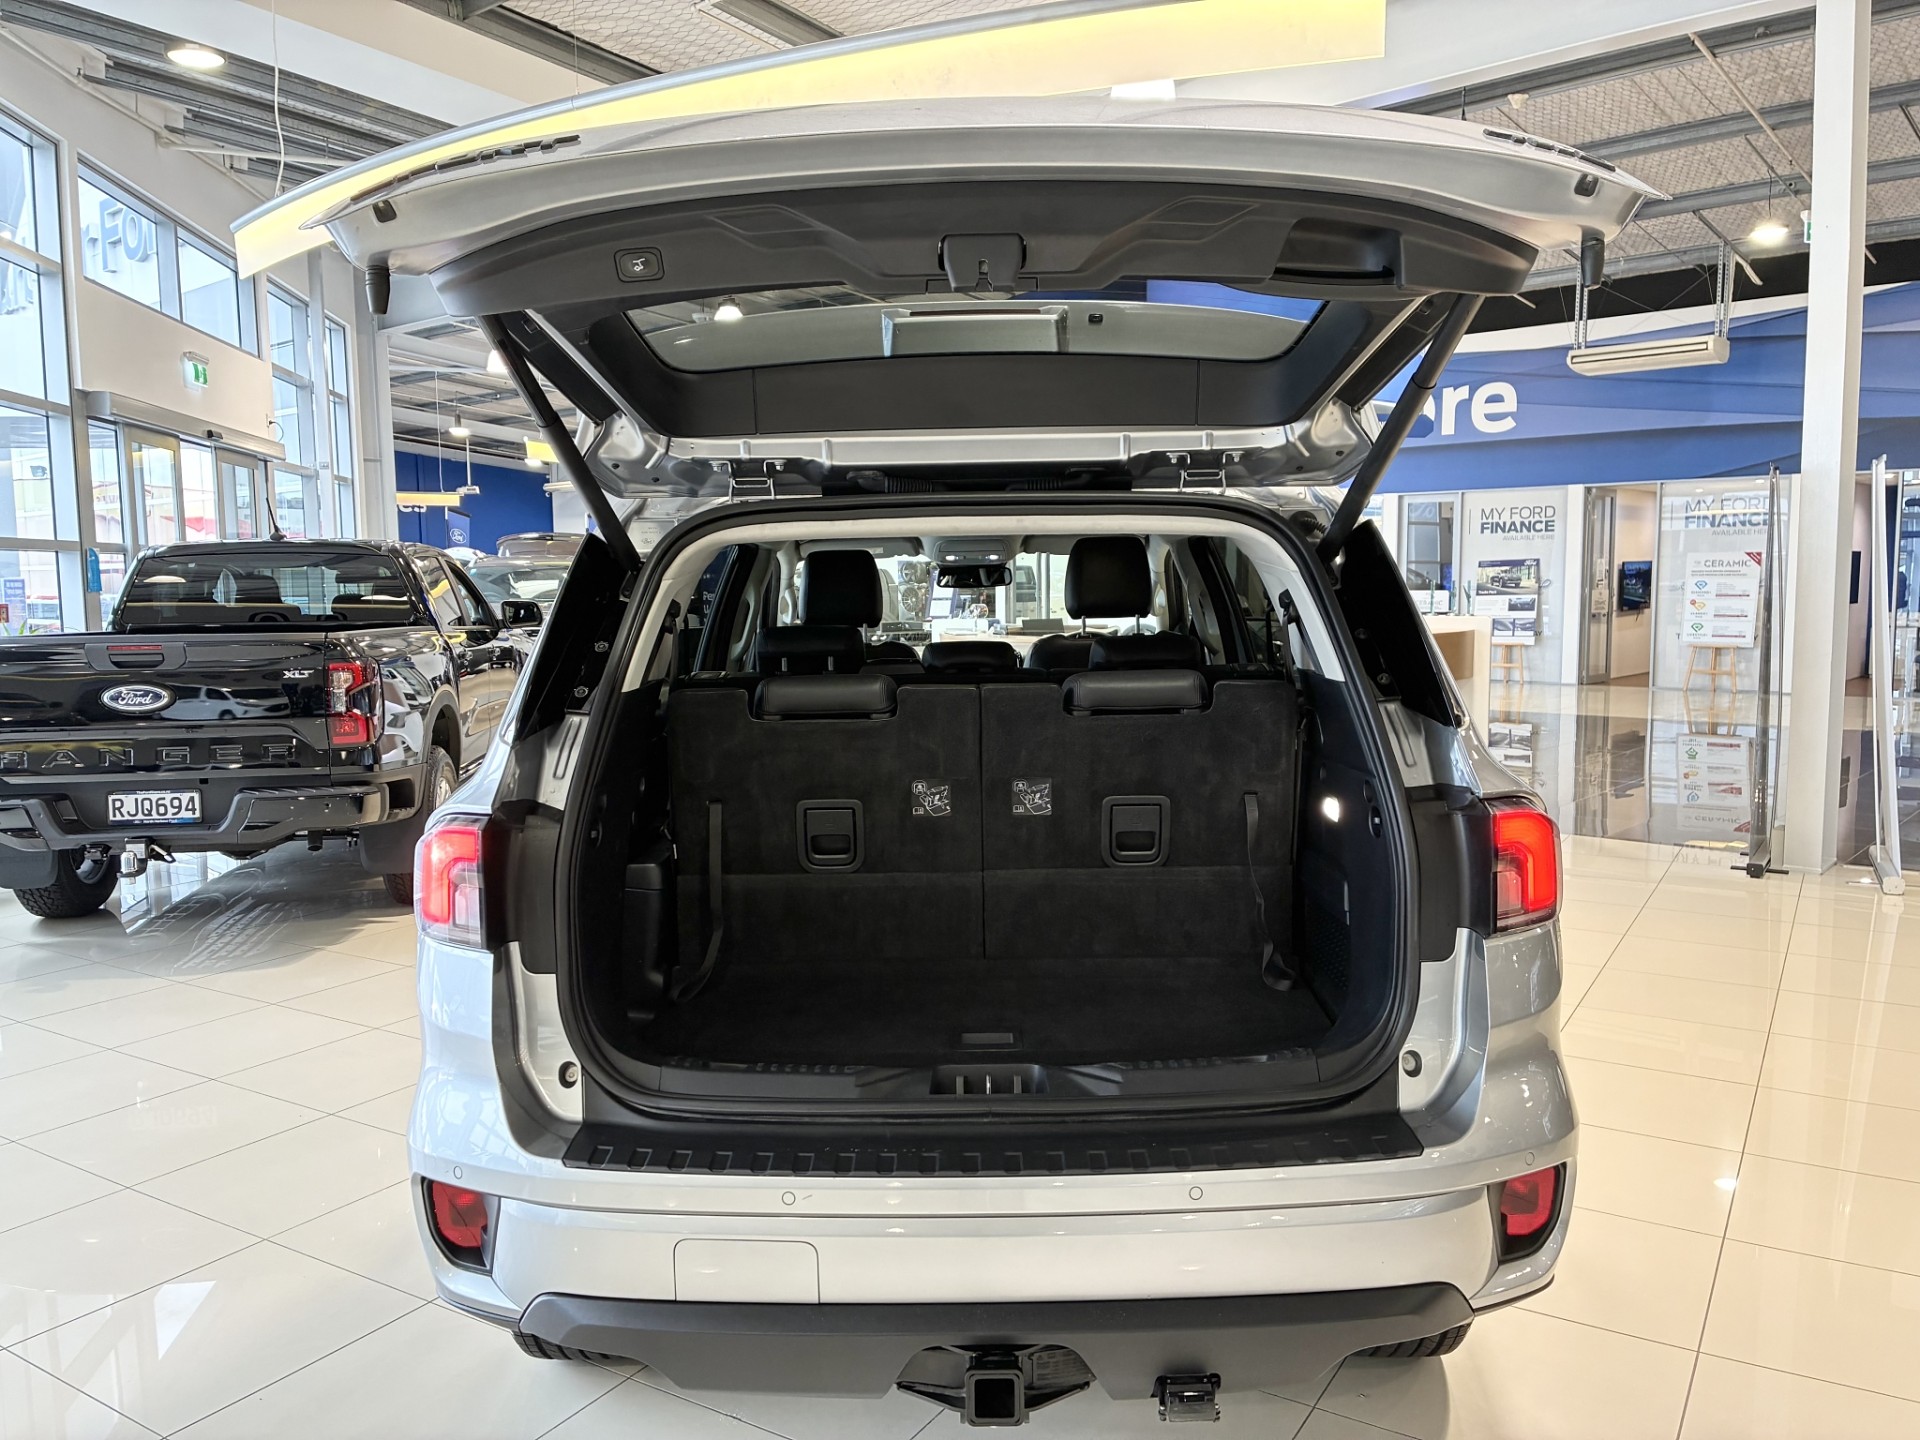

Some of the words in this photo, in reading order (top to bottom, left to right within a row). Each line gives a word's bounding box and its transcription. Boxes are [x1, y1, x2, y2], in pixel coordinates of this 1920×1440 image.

[1480, 506, 1506, 521] MY
[1509, 505, 1556, 520] FORD
[1685, 498, 1715, 513] MY
[1480, 519, 1555, 534] FINANCE
[1711, 528, 1752, 536] AVAILABLE
[1537, 533, 1555, 541] HERE
[1703, 559, 1752, 568] CERAMIC
[283, 669, 314, 679] XLT
[0, 743, 297, 769] RANGER
[111, 795, 197, 818] RJQ694
